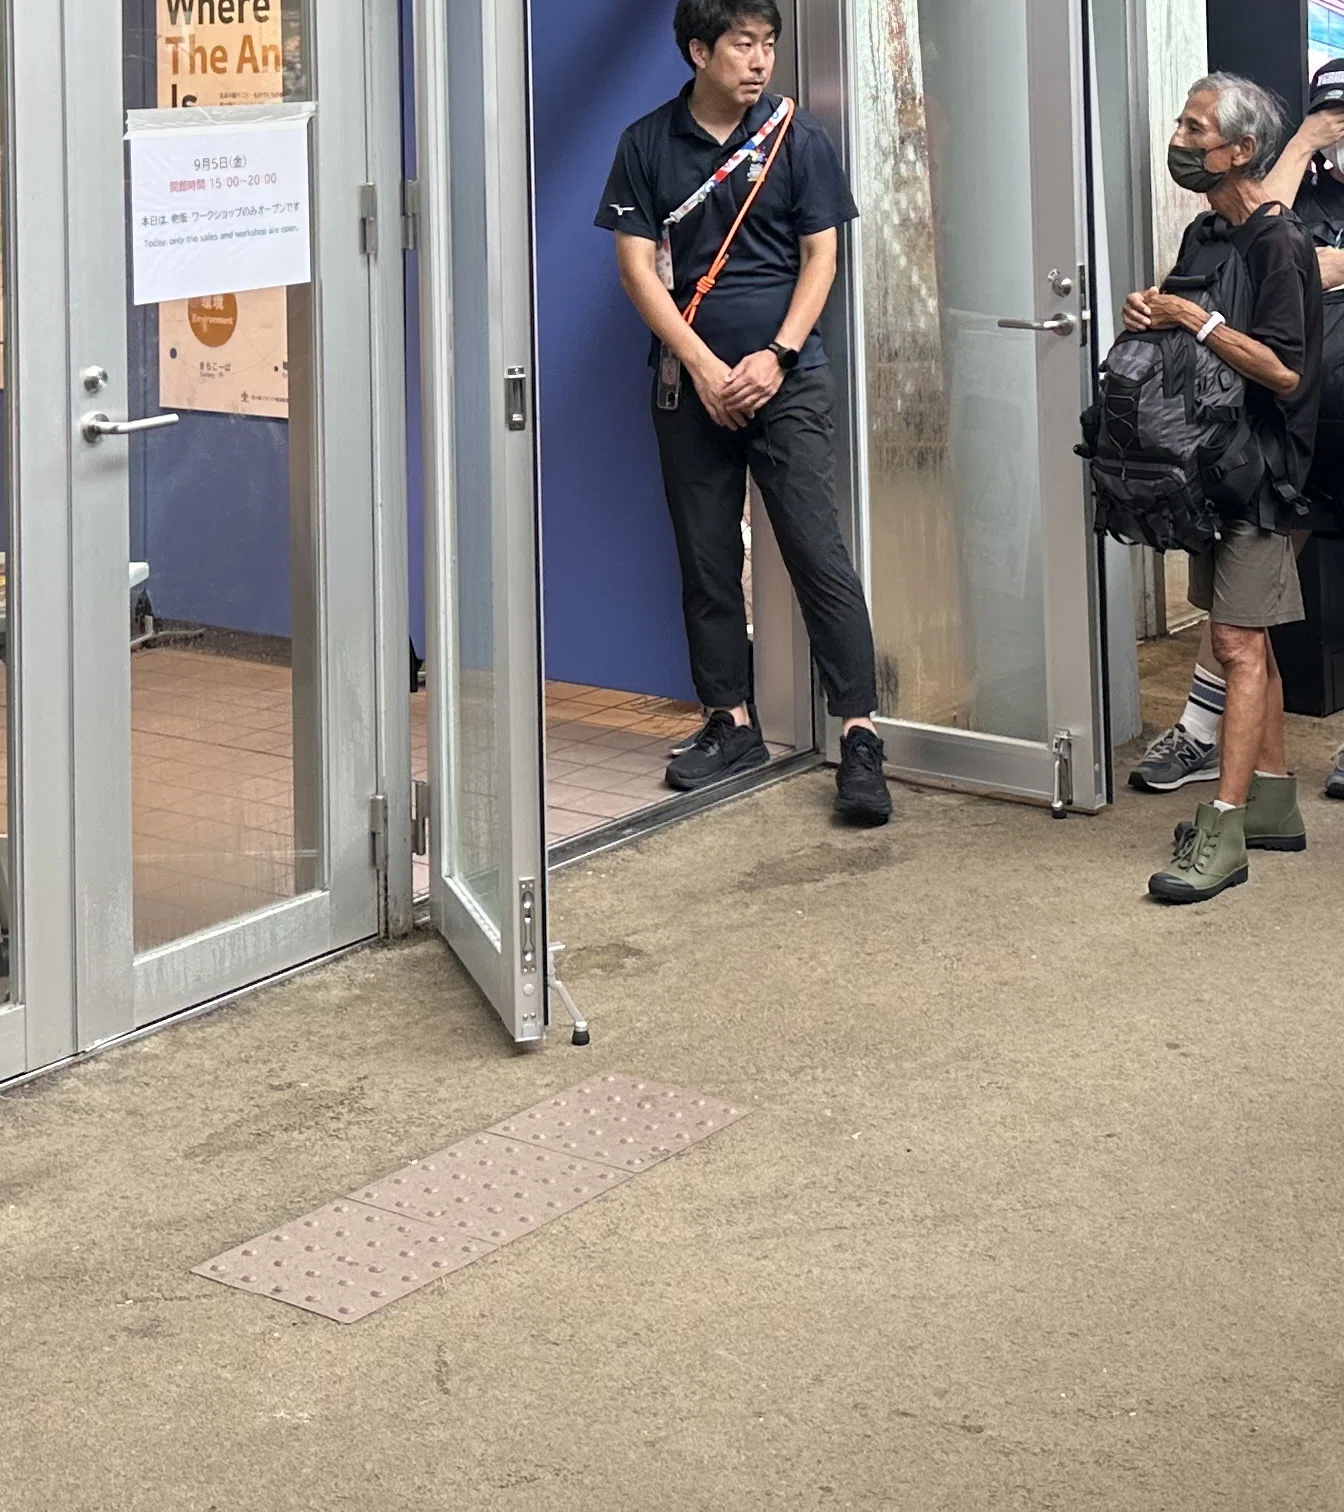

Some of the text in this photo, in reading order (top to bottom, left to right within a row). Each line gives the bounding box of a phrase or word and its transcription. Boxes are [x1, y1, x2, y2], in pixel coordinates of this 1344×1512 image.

[165, 33, 229, 76] The
[220, 231, 234, 240] and
[269, 226, 280, 235] are
